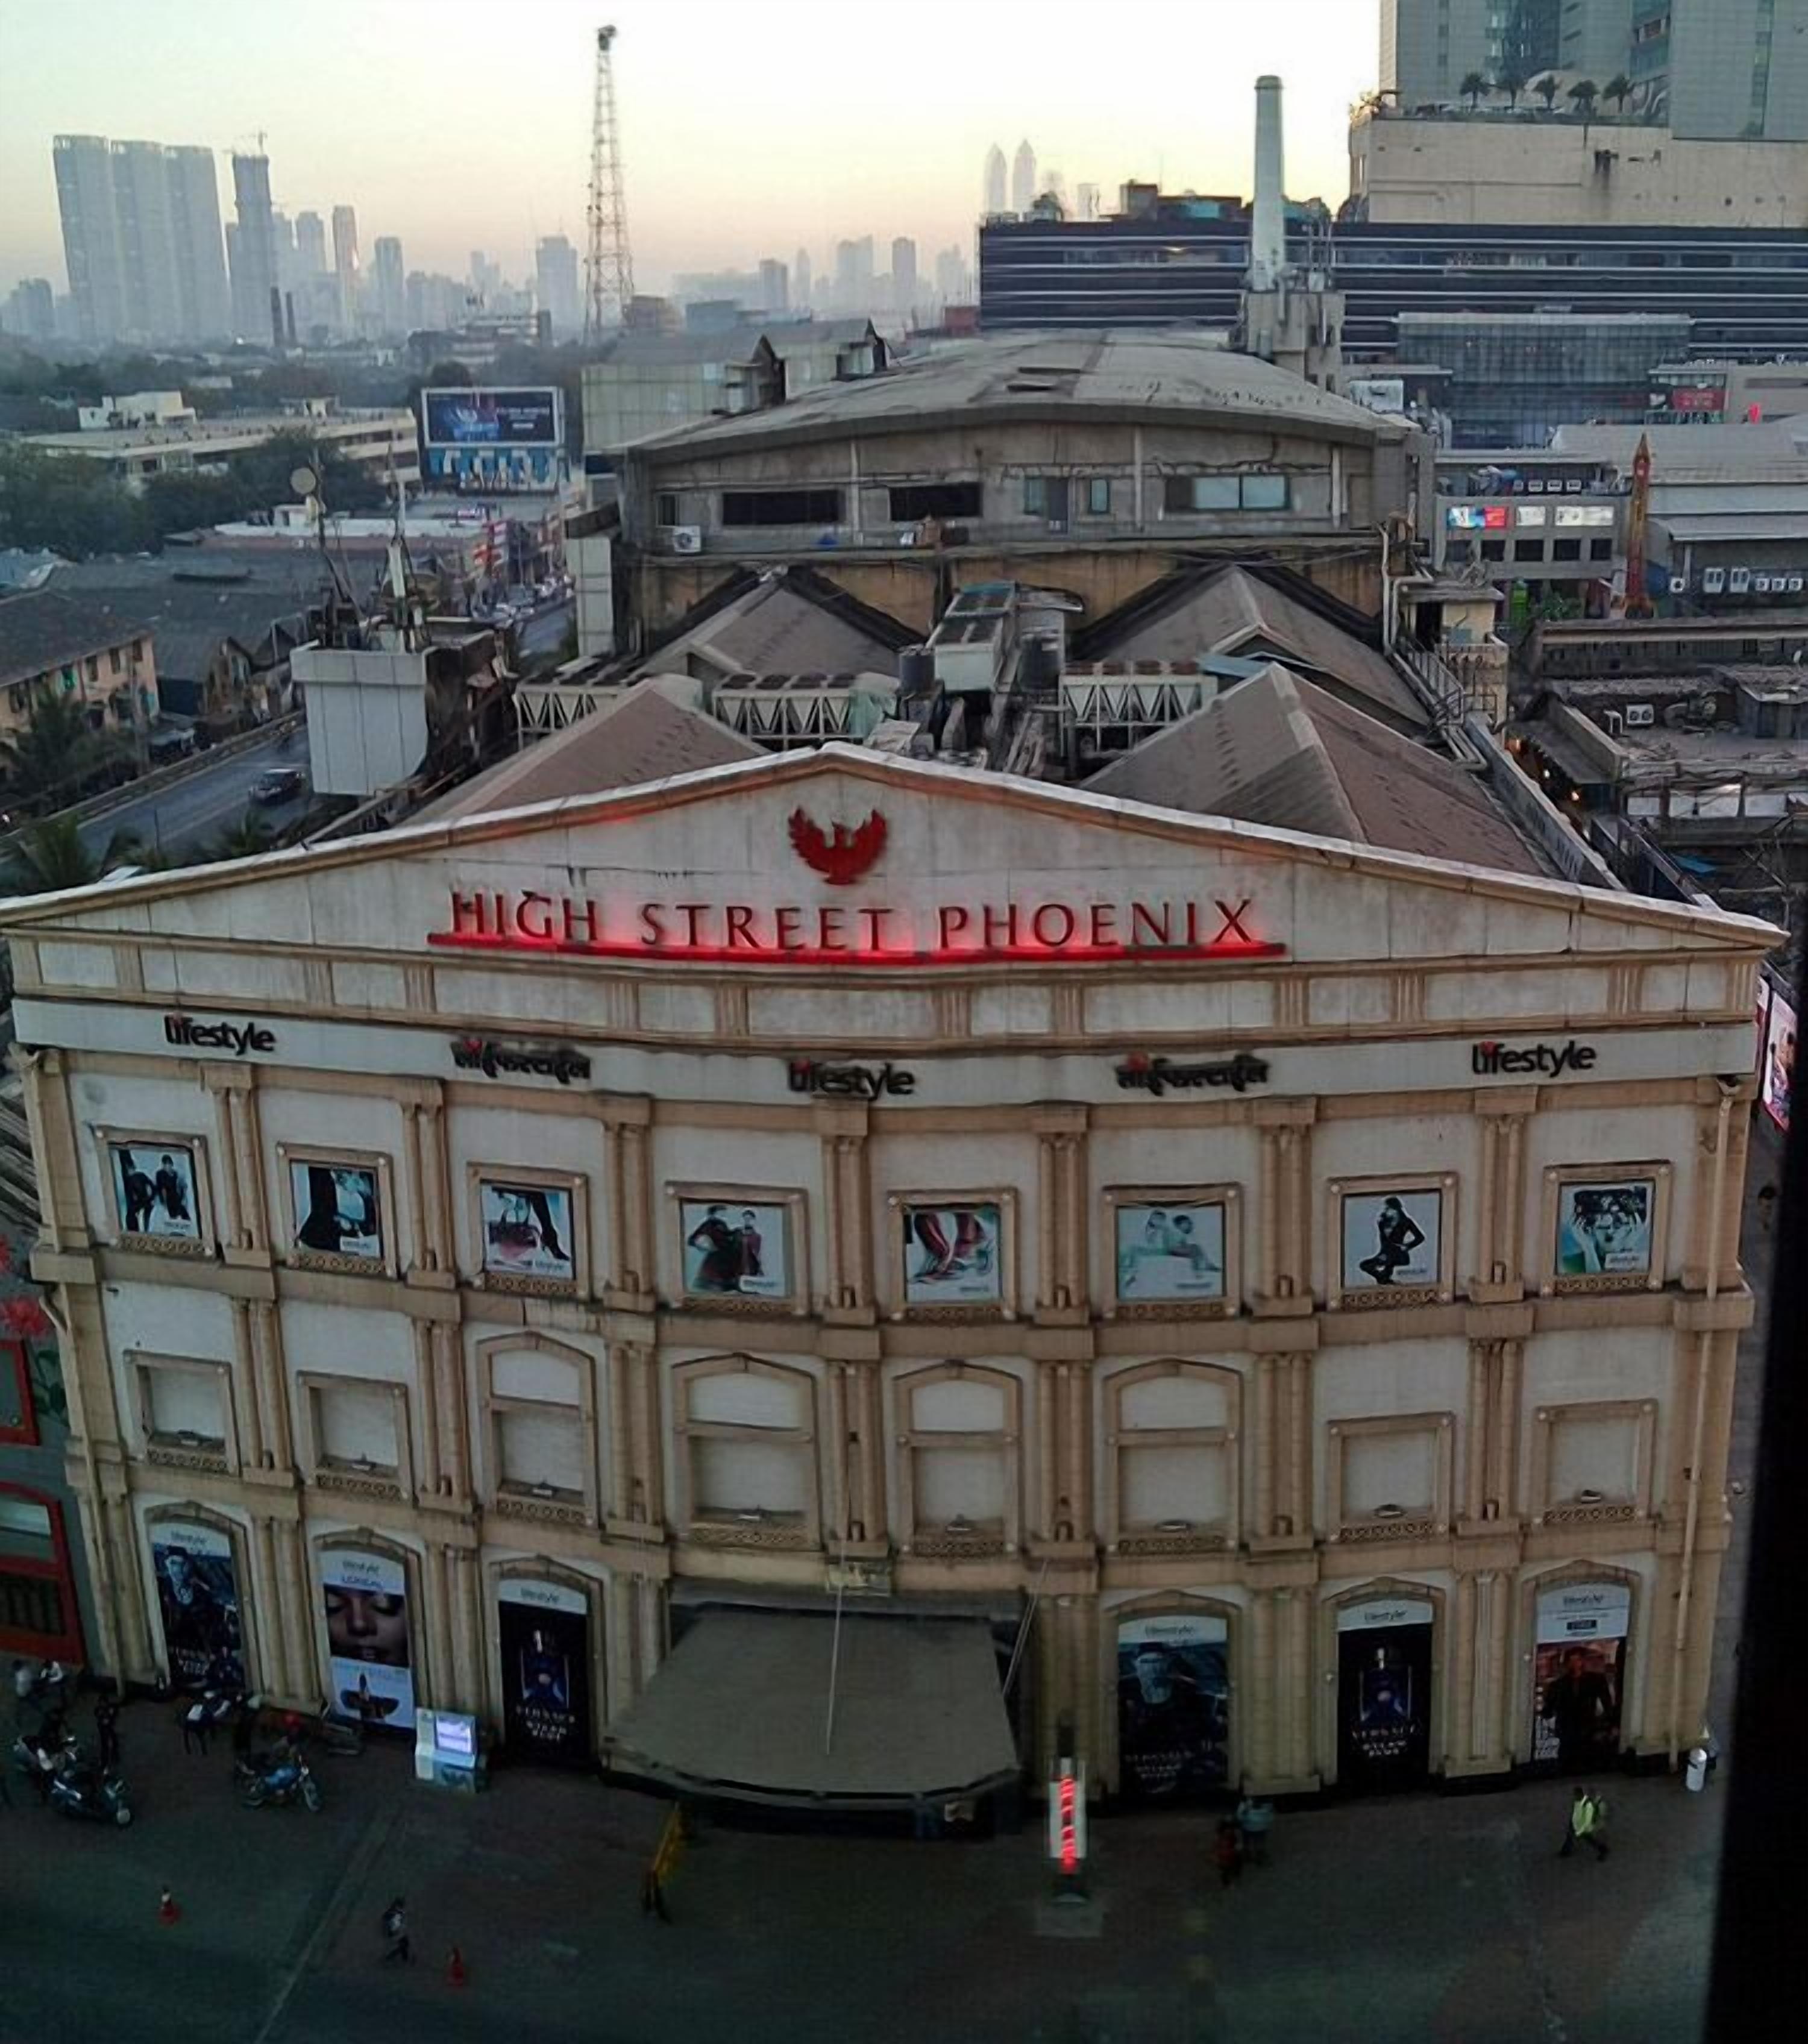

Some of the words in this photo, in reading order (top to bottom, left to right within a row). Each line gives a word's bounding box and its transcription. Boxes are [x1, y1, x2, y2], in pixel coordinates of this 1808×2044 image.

[451, 890, 598, 942] HIGH
[641, 903, 893, 951] STREET
[938, 898, 1253, 949] PHOENIX
[164, 1014, 277, 1056] lifestyle
[1471, 1040, 1598, 1078] lifestyle
